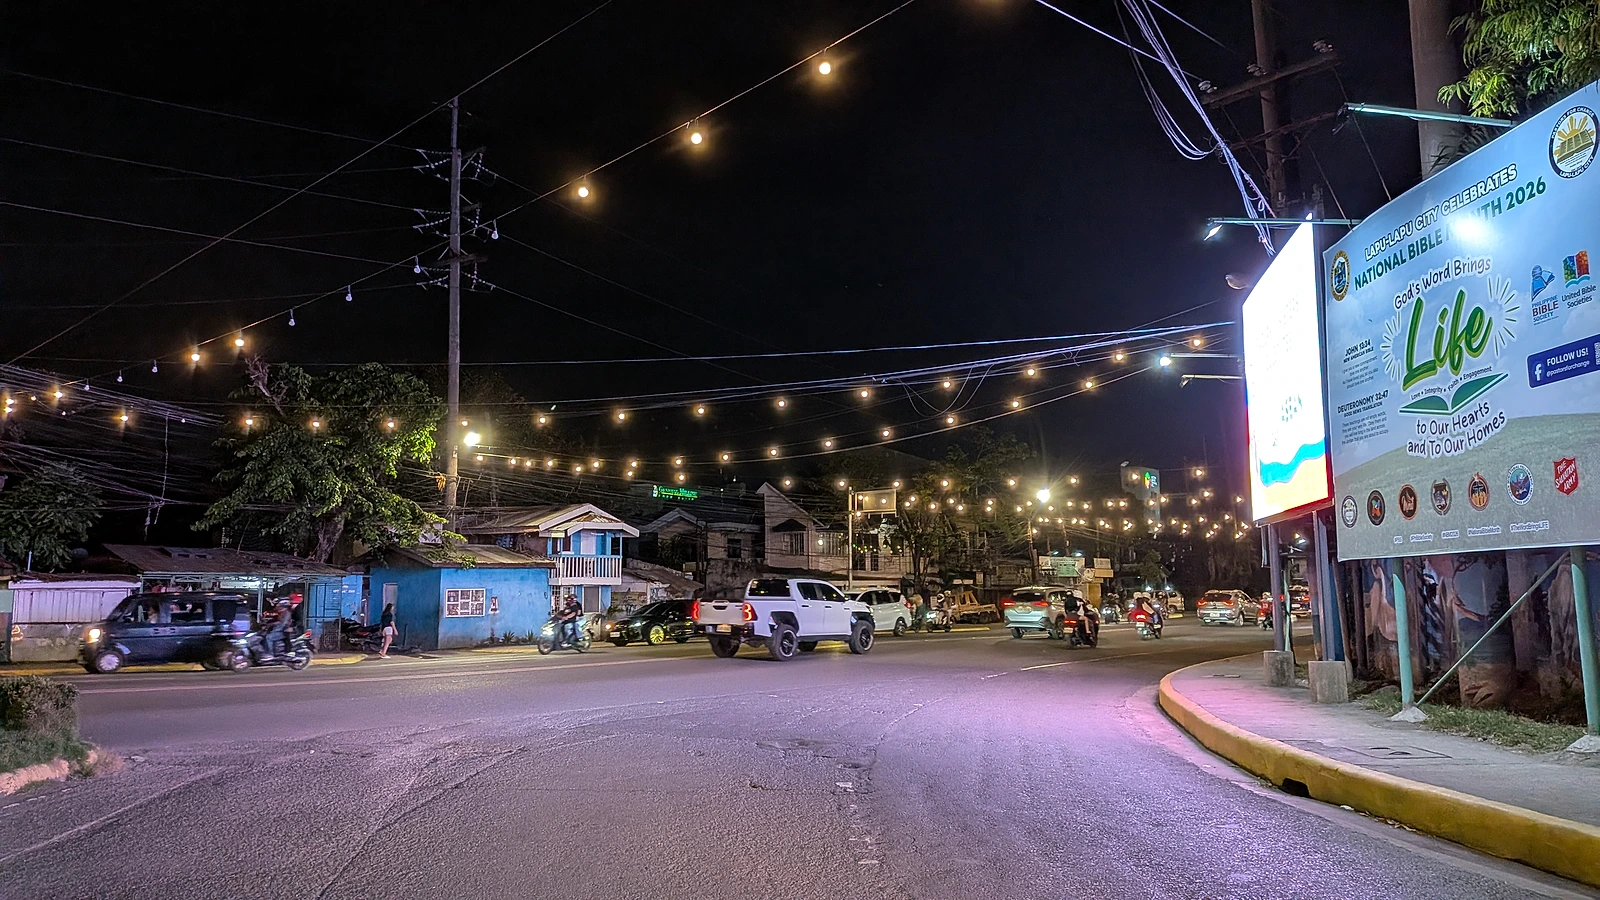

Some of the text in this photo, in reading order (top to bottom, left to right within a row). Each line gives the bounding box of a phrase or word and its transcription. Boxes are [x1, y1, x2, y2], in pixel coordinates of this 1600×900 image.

[1566, 107, 1577, 116] FOR
[1577, 107, 1595, 117] CHANGE
[1584, 155, 1594, 168] CITY
[1364, 163, 1518, 262] LAPU-LAPU CITY CELEBRATES
[1354, 176, 1547, 291] NATIONAL BIBLE NTH 2026
[1394, 257, 1491, 309] God's Word Brings
[1561, 284, 1597, 302] United Bible
[1567, 295, 1593, 309] Societies
[1532, 300, 1559, 317] BIBLE
[1533, 311, 1553, 323] SOCIETY
[1403, 289, 1493, 391] Life
[1345, 345, 1358, 357] JOHN
[1546, 347, 1589, 366] FOLLOW US!
[1410, 366, 1492, 401] Love Integrity Faith Engagement
[1337, 394, 1374, 414] DEUTERONOMY
[1416, 401, 1490, 435] to Our Hearts
[1407, 411, 1506, 456] and To Our Homes
[1557, 460, 1567, 474] THE
[1563, 472, 1576, 492] ARMY
